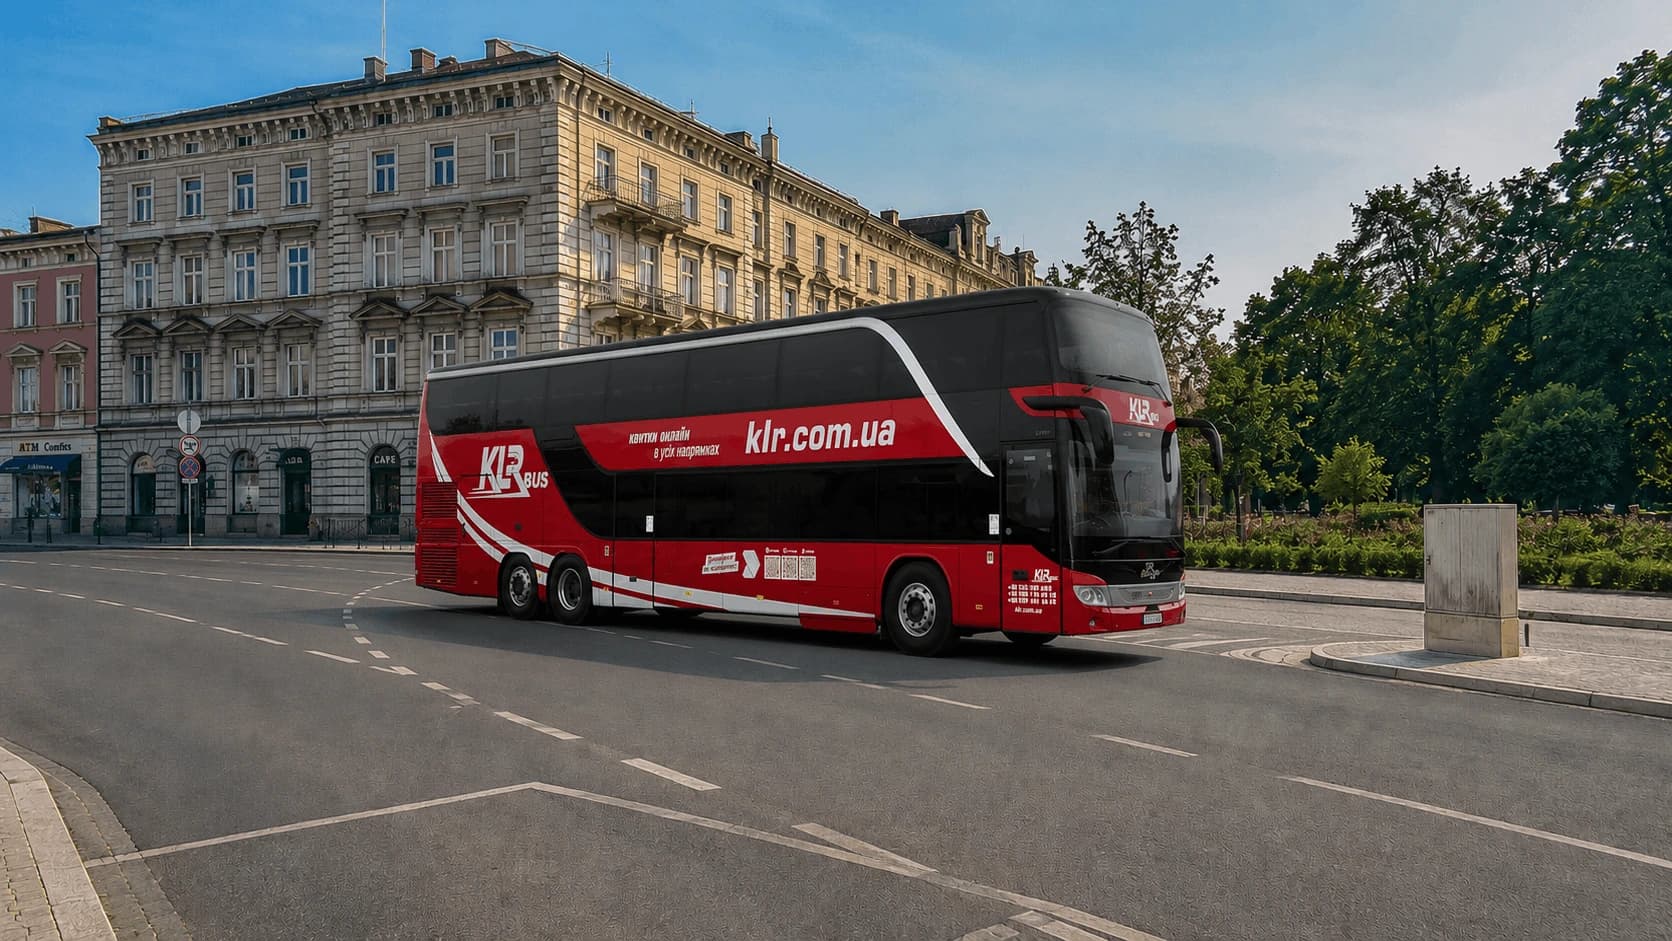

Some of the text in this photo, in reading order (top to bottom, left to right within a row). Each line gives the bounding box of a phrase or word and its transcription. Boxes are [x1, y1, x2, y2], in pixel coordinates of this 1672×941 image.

[660, 426, 691, 443] онлайн
[745, 418, 897, 454] klr.com.ua
[660, 444, 675, 462] усіх
[466, 444, 549, 499] KLR BUS
